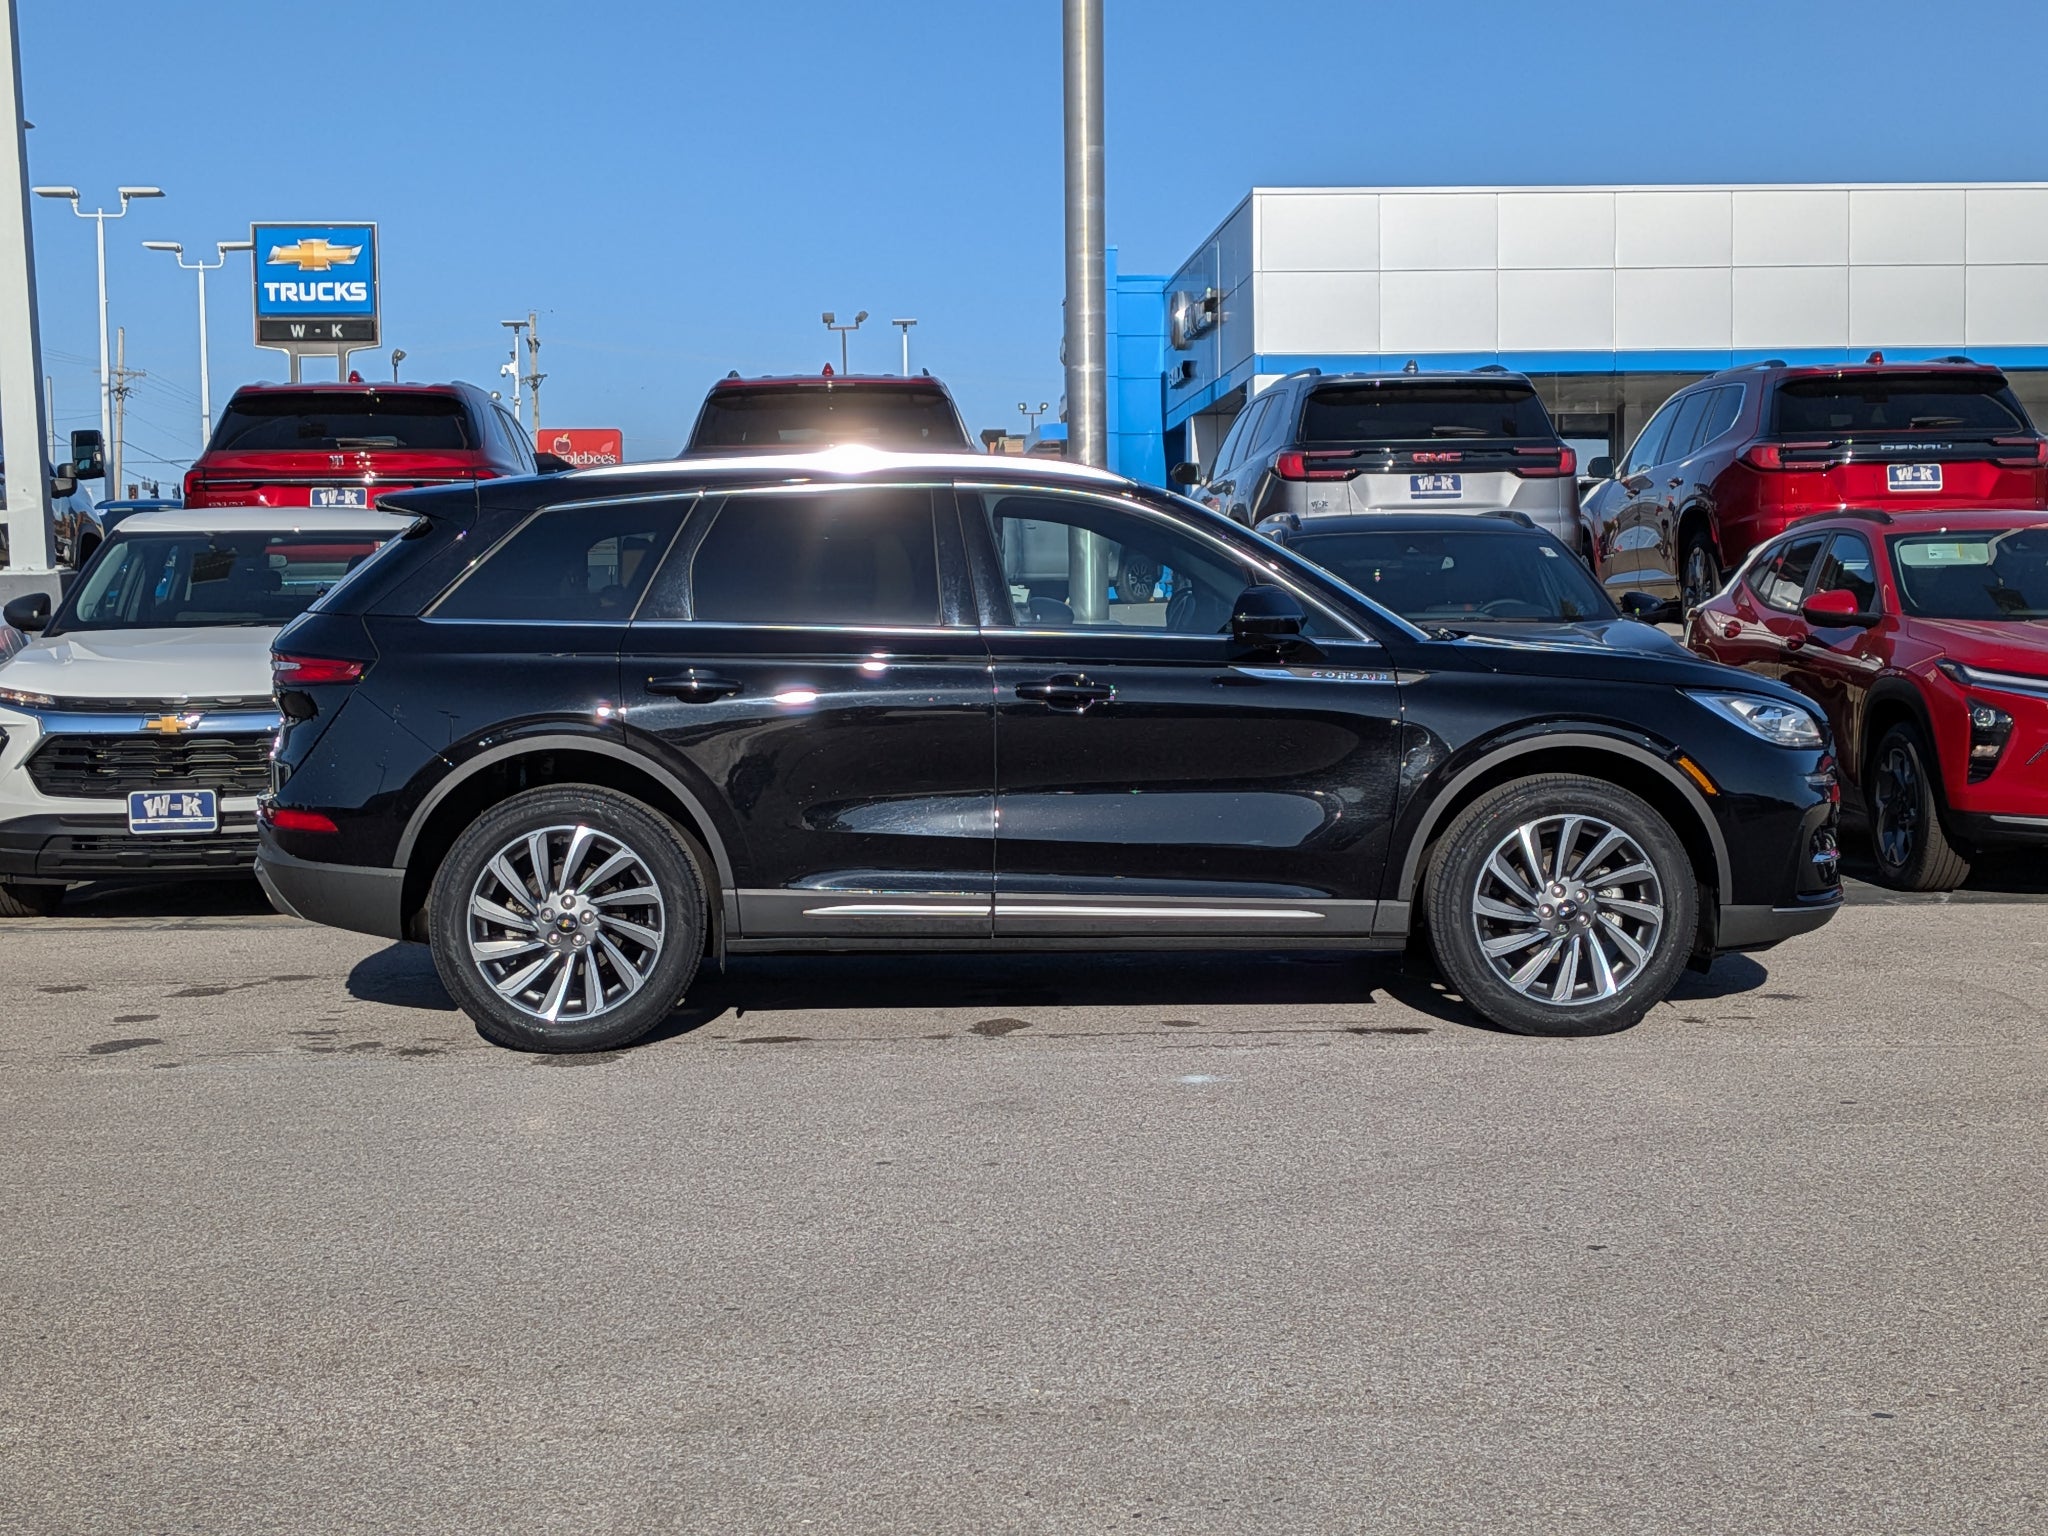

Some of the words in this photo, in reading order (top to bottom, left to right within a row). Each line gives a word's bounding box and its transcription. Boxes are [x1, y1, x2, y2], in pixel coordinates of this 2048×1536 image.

[263, 282, 367, 302] TRUCKS
[548, 449, 616, 465] plebee's
[1412, 453, 1462, 462] GMC
[1896, 466, 1933, 481] W-K
[1417, 475, 1454, 491] W-K
[319, 490, 358, 505] W-K
[143, 794, 203, 818] W-K
